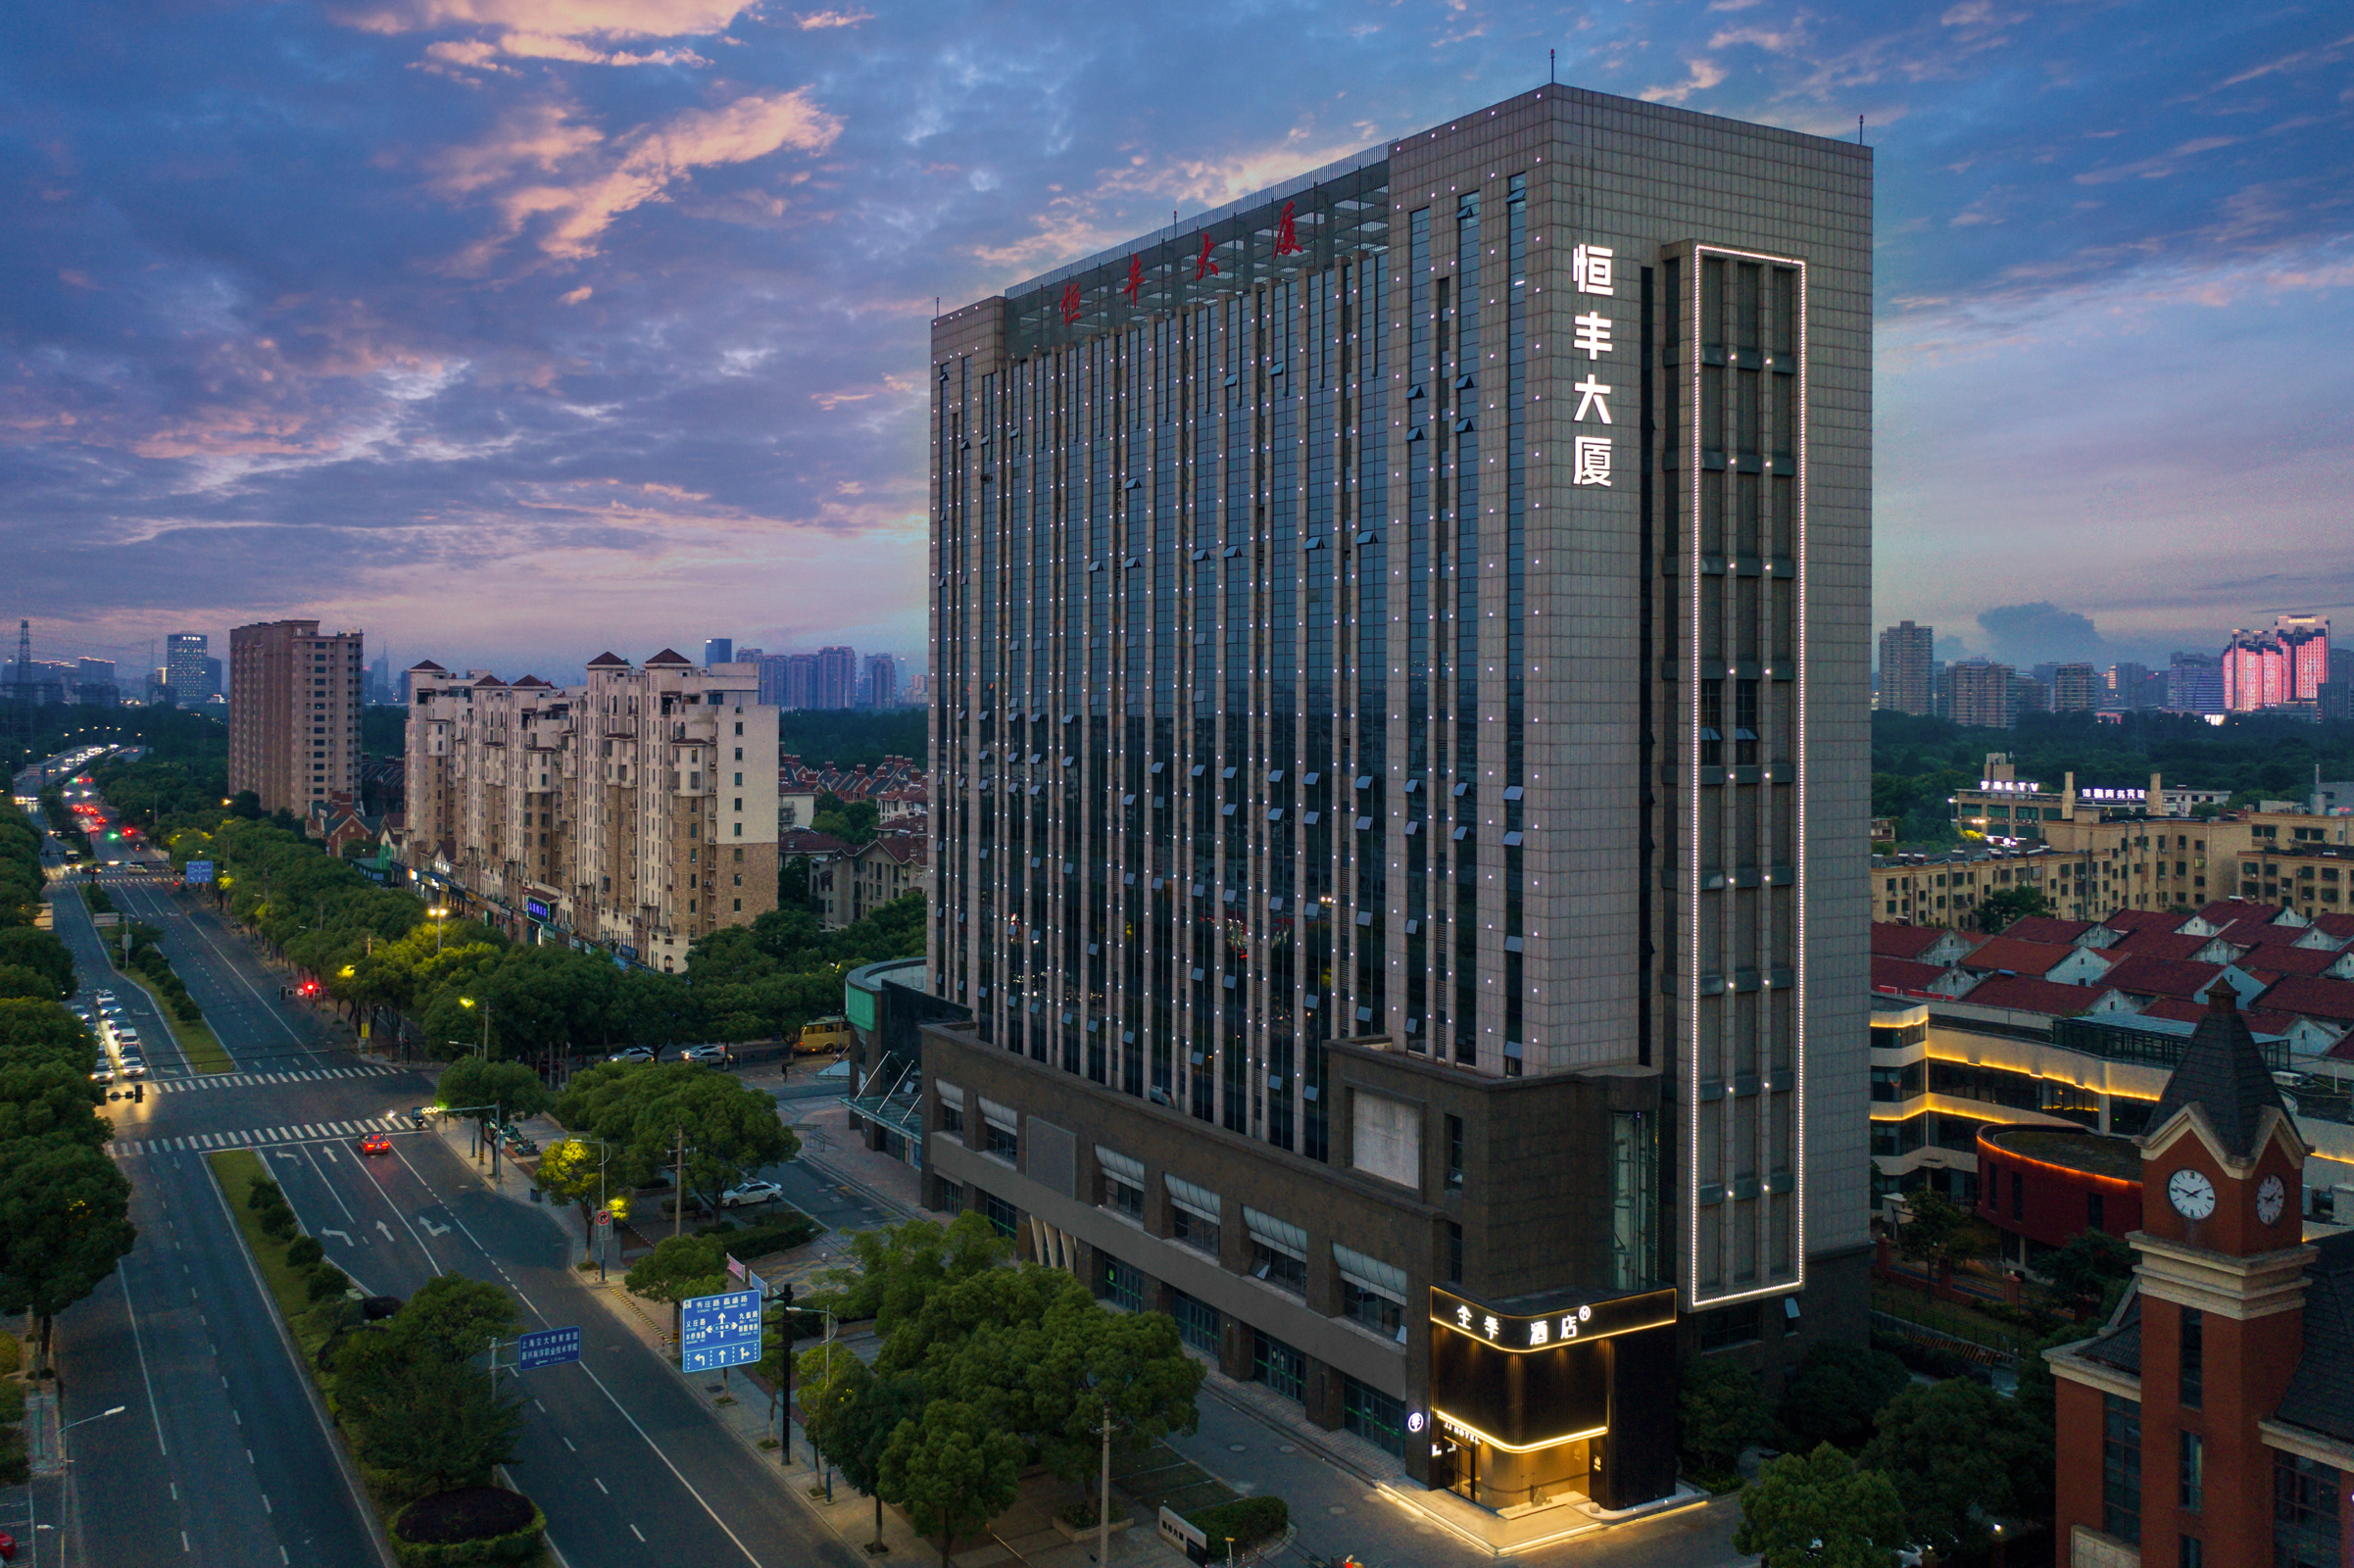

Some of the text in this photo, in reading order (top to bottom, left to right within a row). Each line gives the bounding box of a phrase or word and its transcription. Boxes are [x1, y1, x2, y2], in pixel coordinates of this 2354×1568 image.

[1060, 200, 1302, 327] 恒丰大厦
[1572, 244, 1614, 487] 恒丰大厦
[1456, 1304, 1578, 1346] 全季酒店
[1454, 1426, 1481, 1445] HOTEL
